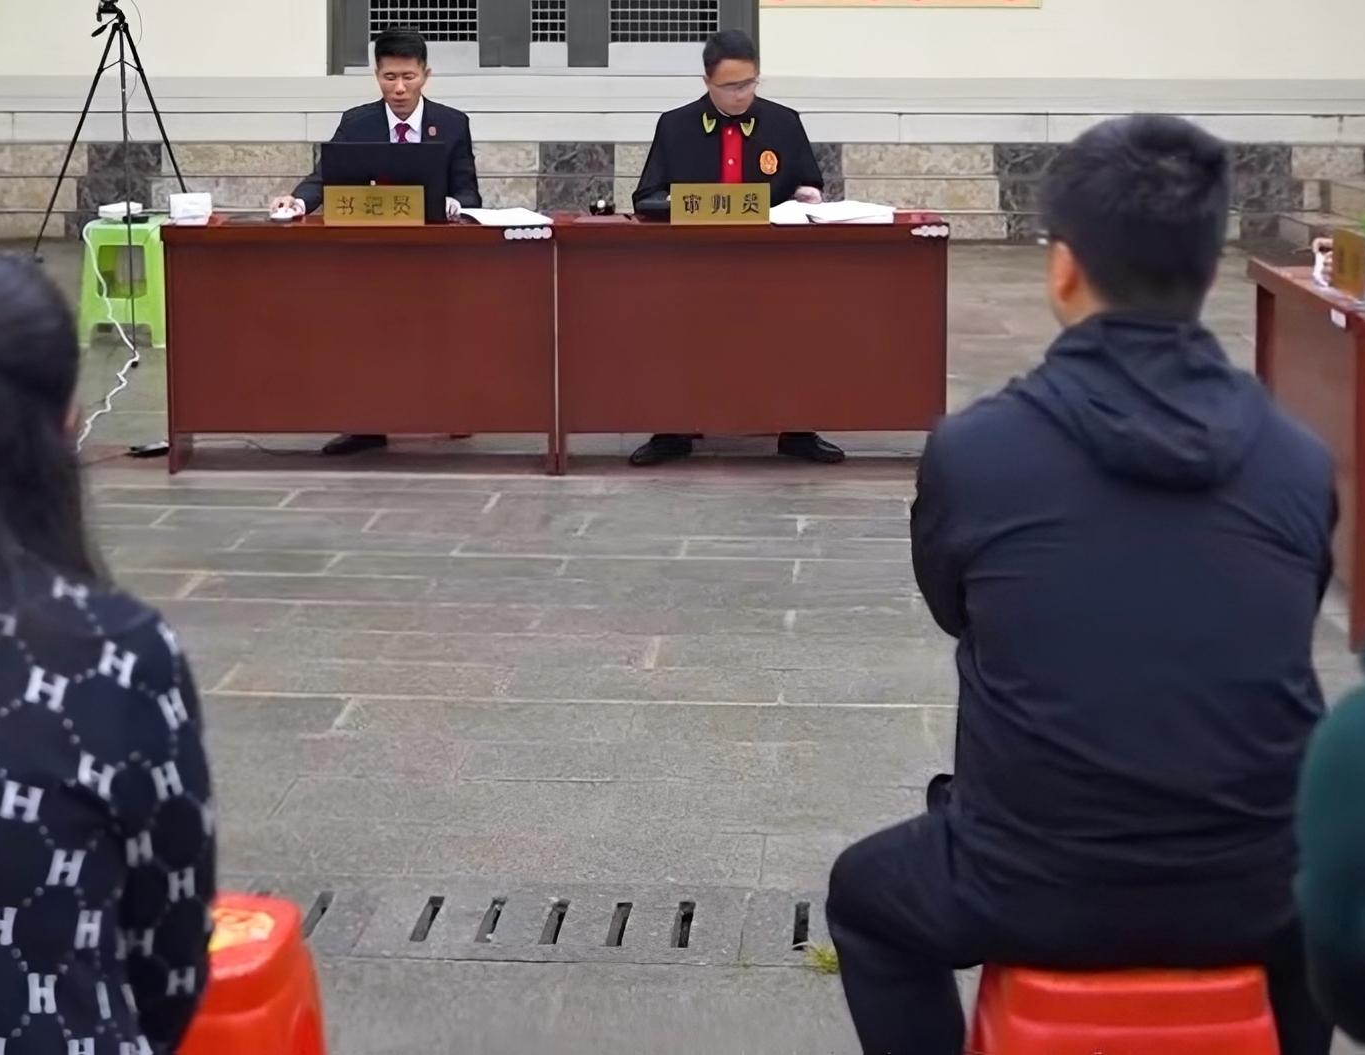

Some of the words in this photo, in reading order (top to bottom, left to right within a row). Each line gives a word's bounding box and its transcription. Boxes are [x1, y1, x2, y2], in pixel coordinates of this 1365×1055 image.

[336, 195, 411, 216] 书记员
[682, 193, 759, 215] 审判员
[98, 641, 137, 688] H
[24, 665, 69, 713] H
[157, 687, 188, 730] H
[78, 750, 116, 800] H
[151, 760, 184, 801] H
[45, 848, 86, 886] H
[126, 830, 153, 868] H
[168, 866, 195, 903] H
[74, 909, 102, 950] H
[27, 972, 57, 1014] H
[166, 966, 196, 996] H
